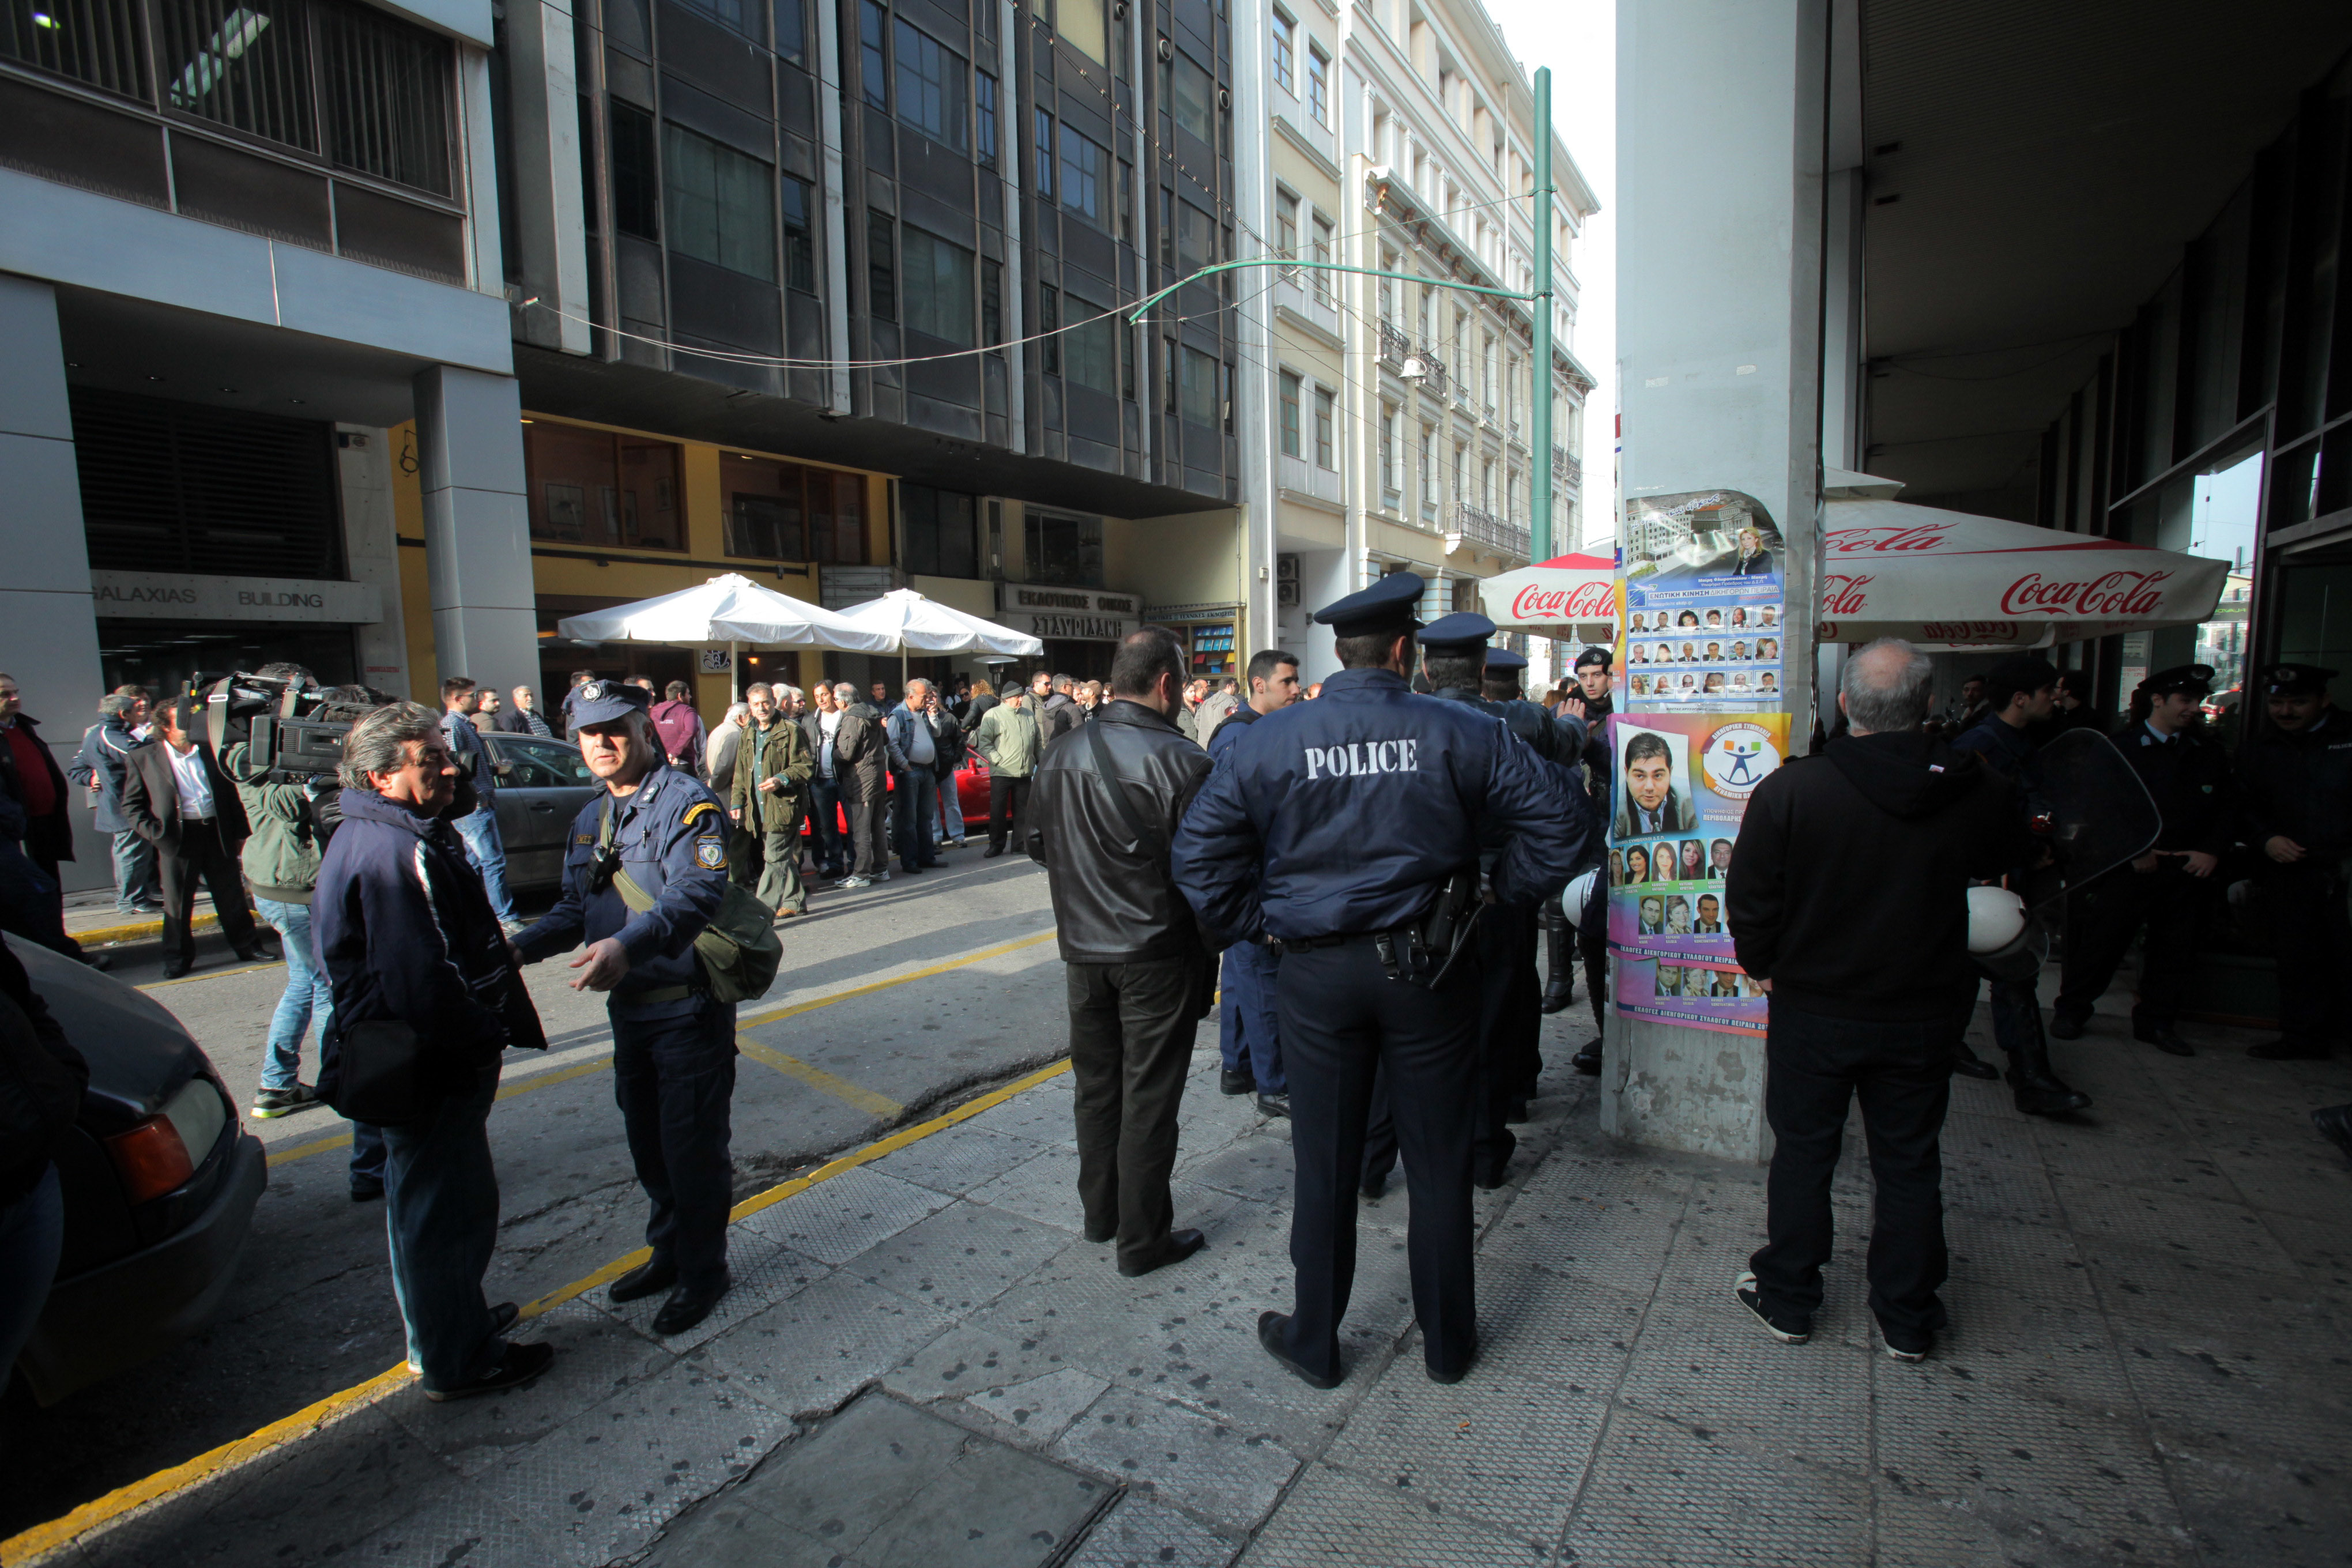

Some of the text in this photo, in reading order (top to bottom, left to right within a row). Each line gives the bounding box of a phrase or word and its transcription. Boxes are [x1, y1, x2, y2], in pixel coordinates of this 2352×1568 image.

[239, 591, 323, 608] BUILDING
[1019, 590, 1133, 612] ΕΚΔΟΤΙΚΟΣ ΟΙΚΟΣ
[2001, 570, 2176, 615] Coca-Cola
[1032, 615, 1122, 637] ΣΤΑΥΡΙΔΑΚΗ
[1712, 723, 1771, 740] ΔΙΚΗΓΟΡΙΚΗ ΣΥΜΜΑΧΙΑ
[1305, 739, 1418, 779] POLICE
[1713, 786, 1742, 799] ΔΥΝΑΜΙΚΗ
[1620, 945, 1739, 965] ΕΚΛΟΓΕΣ ΔΙΚΗΓΟΡΙΚΟΥ ΣΥΛΛΟΓΟΥ ΠΕΙΡΑΙΑ
[1634, 1006, 1659, 1015] ΕΚΛΟΓΕΣ
[1660, 1009, 1698, 1020] ΔΙΚΗΓΟΡΙΚΟΥ
[1700, 1015, 1729, 1024] ΣΥΛΛΟΓΟΥ
[1731, 1019, 1755, 1029] ΠΕΙΡΑΙΑ
